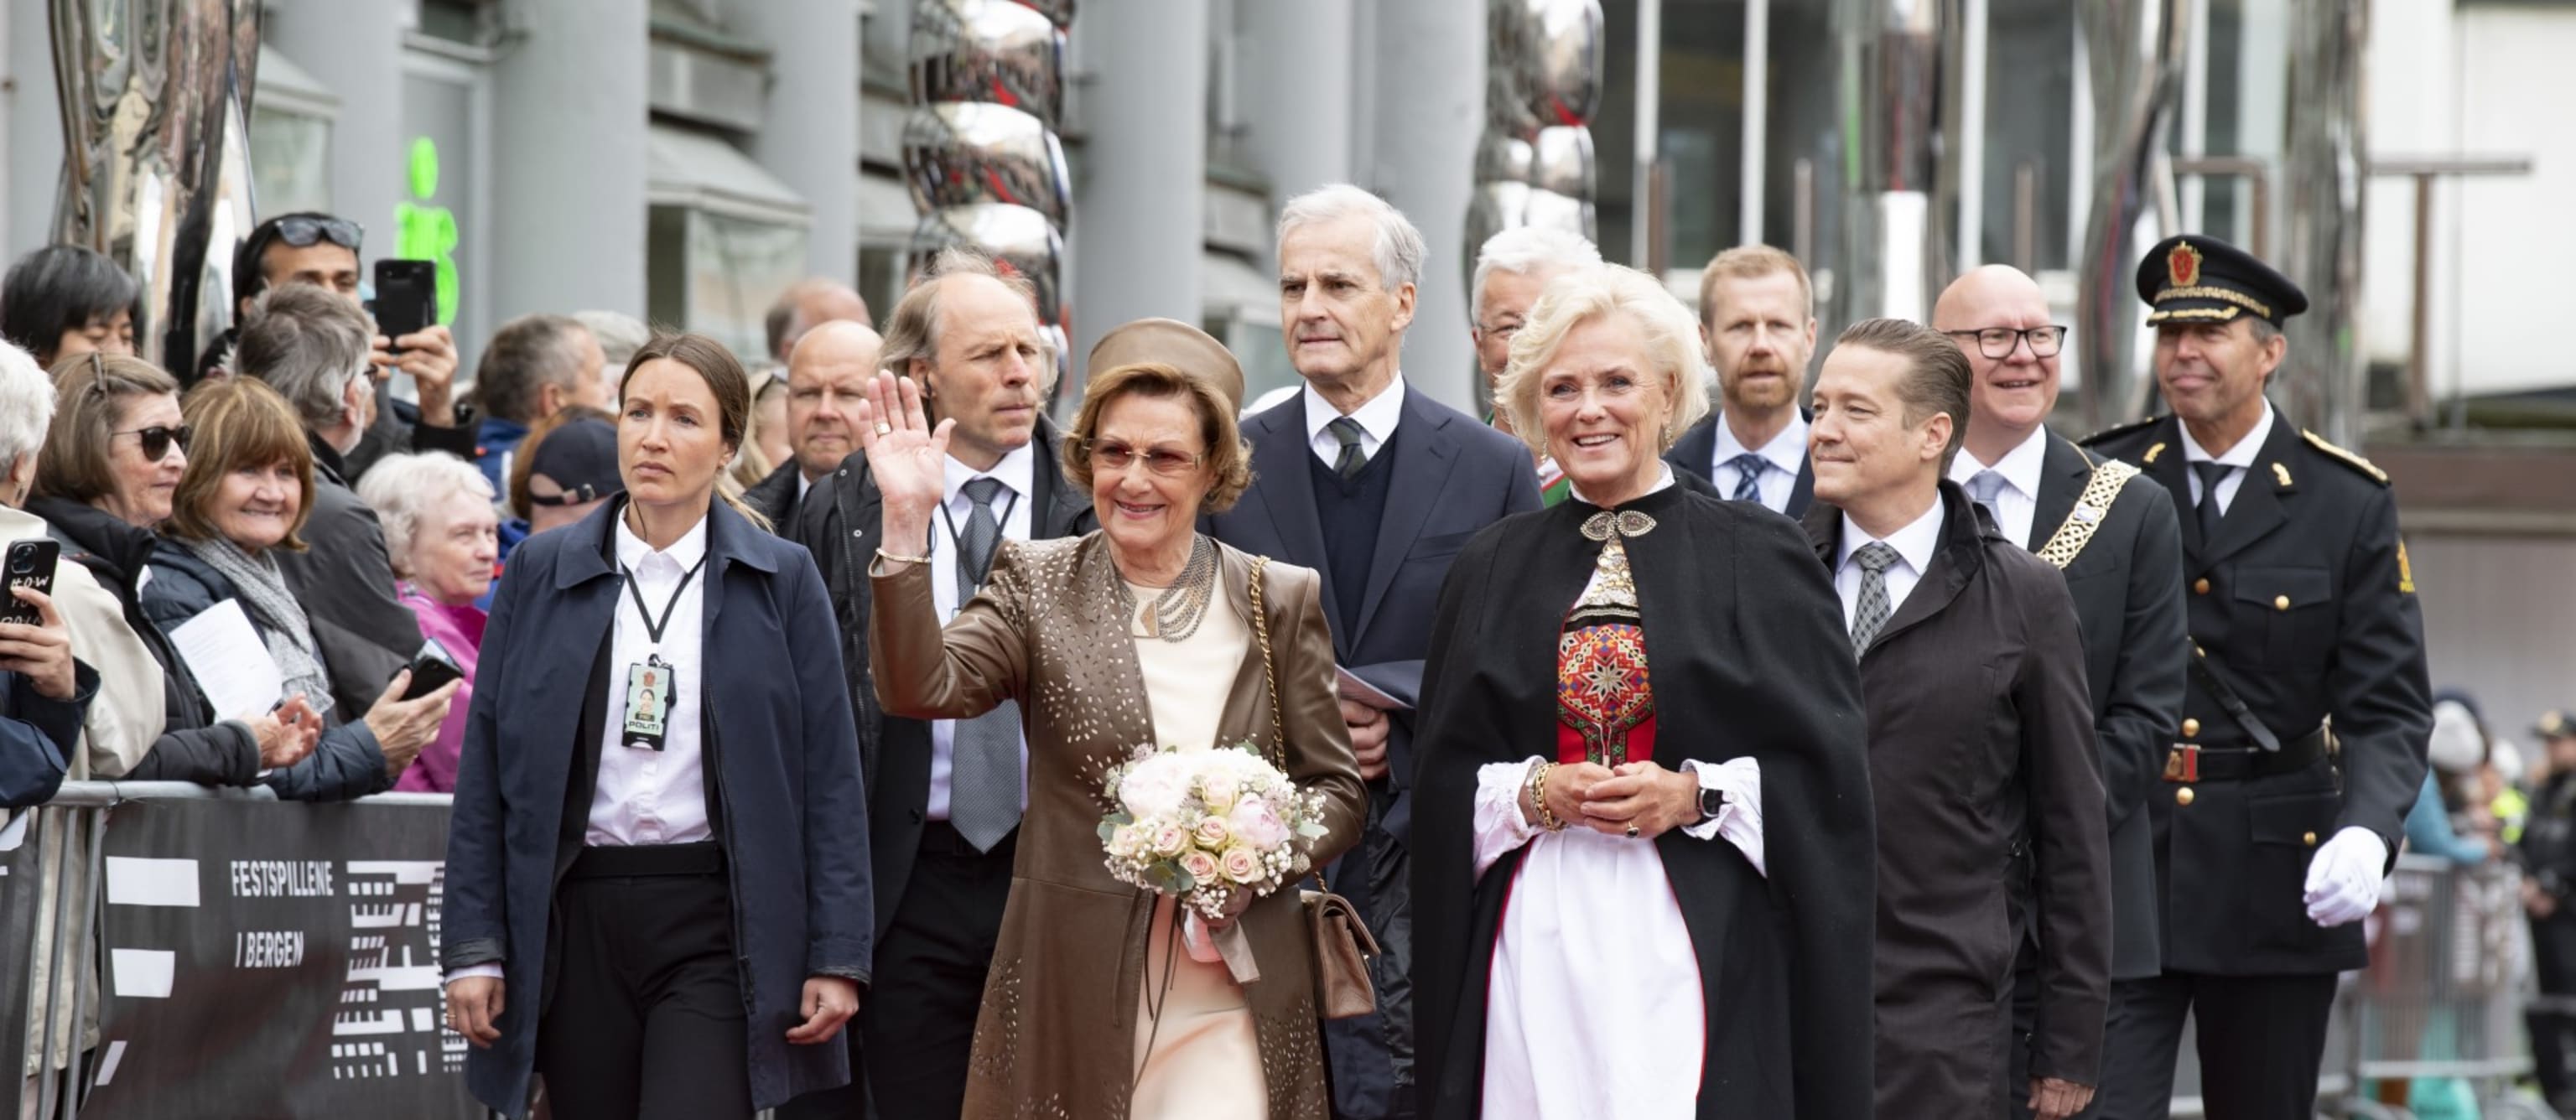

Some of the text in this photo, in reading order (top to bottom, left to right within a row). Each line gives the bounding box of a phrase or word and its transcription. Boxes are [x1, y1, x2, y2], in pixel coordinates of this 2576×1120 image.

[629, 721, 659, 730] POLITI
[231, 860, 335, 896] FESTSPILLENE
[235, 931, 304, 968] I BERGEN
